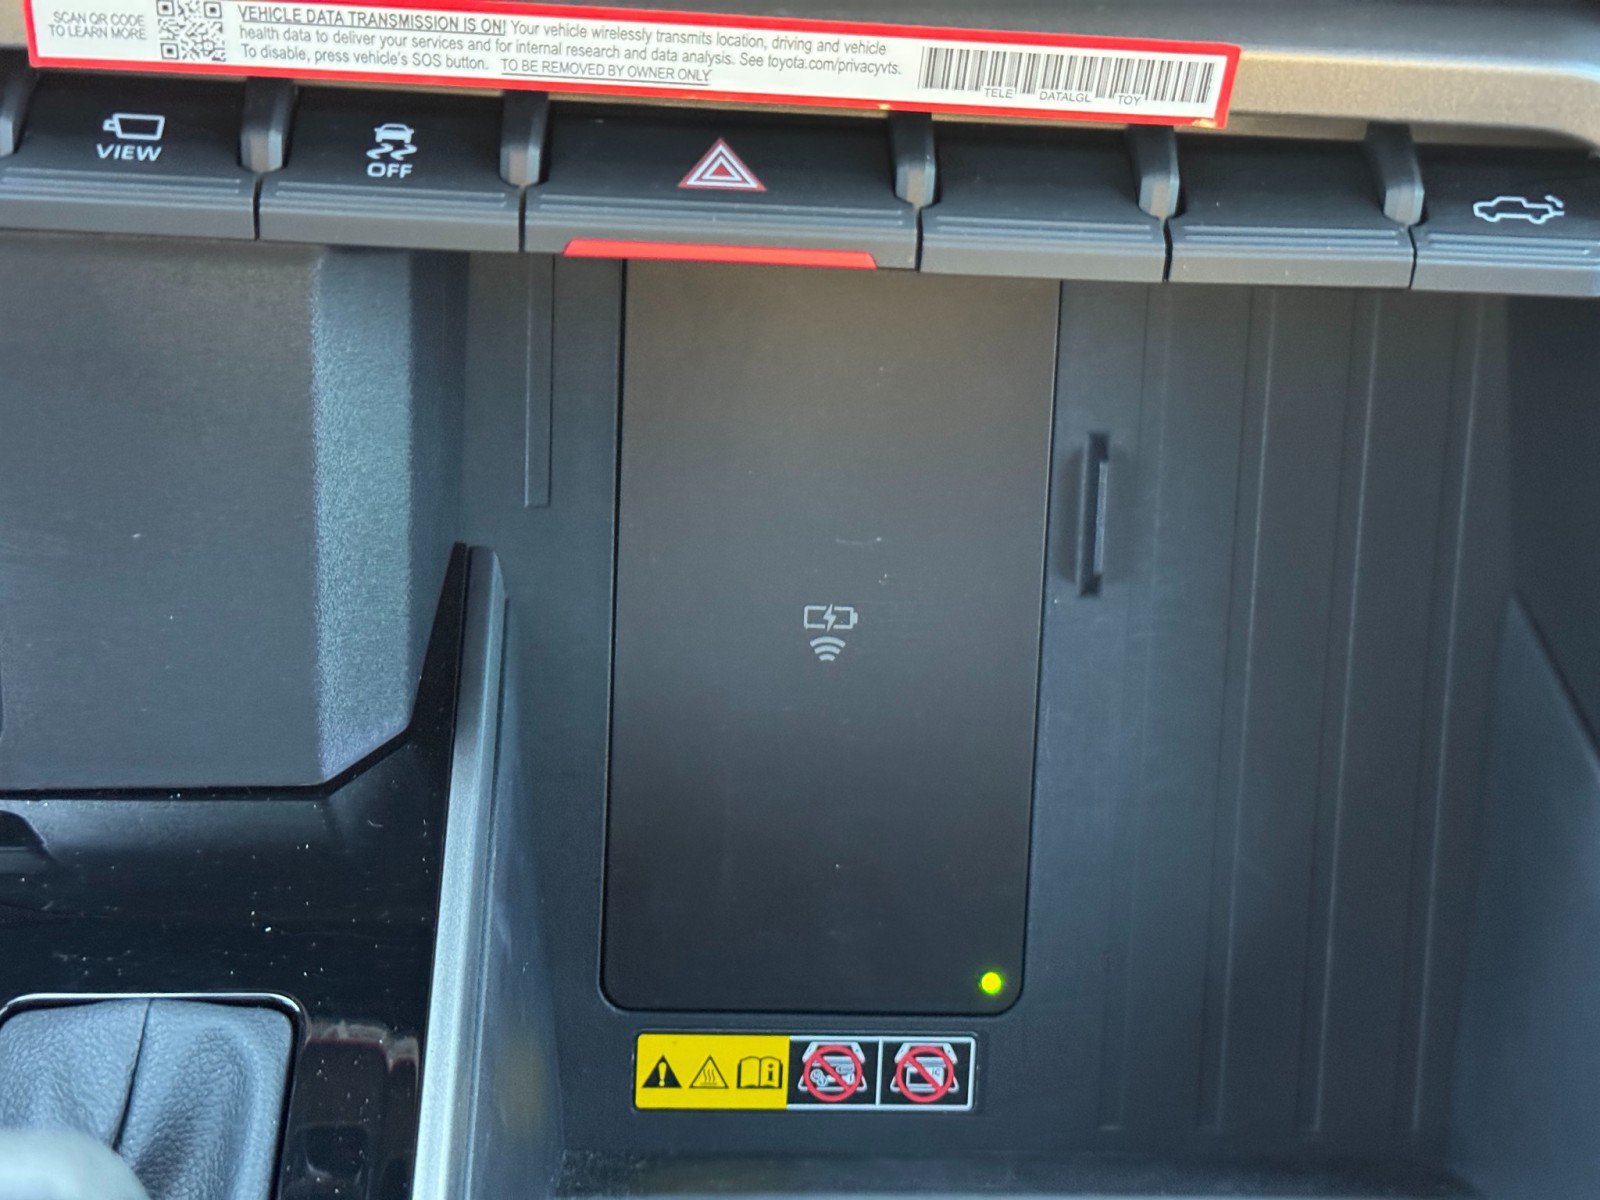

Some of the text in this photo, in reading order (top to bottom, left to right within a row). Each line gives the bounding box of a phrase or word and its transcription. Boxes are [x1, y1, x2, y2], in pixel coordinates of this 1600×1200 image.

[53, 11, 86, 24] SCAN
[110, 13, 145, 26] CODE
[49, 25, 146, 40] TO LEARN MORE
[238, 5, 886, 55] VEHICLE DATA TRANSMISSION IS ON! Your vehicle wirelessly transmits location, driving and vehicle
[240, 25, 902, 77] health data to deliver your services and for internal research and data analysis. See toyota.com/privacyvts.
[241, 43, 712, 82] To disable, press vehicle's SOS button. TO BE REMOVED BY OWNER ONLY
[984, 88, 1142, 106] TELE DATALGL TOY
[96, 144, 162, 162] VIEW
[366, 162, 413, 178] OFF
